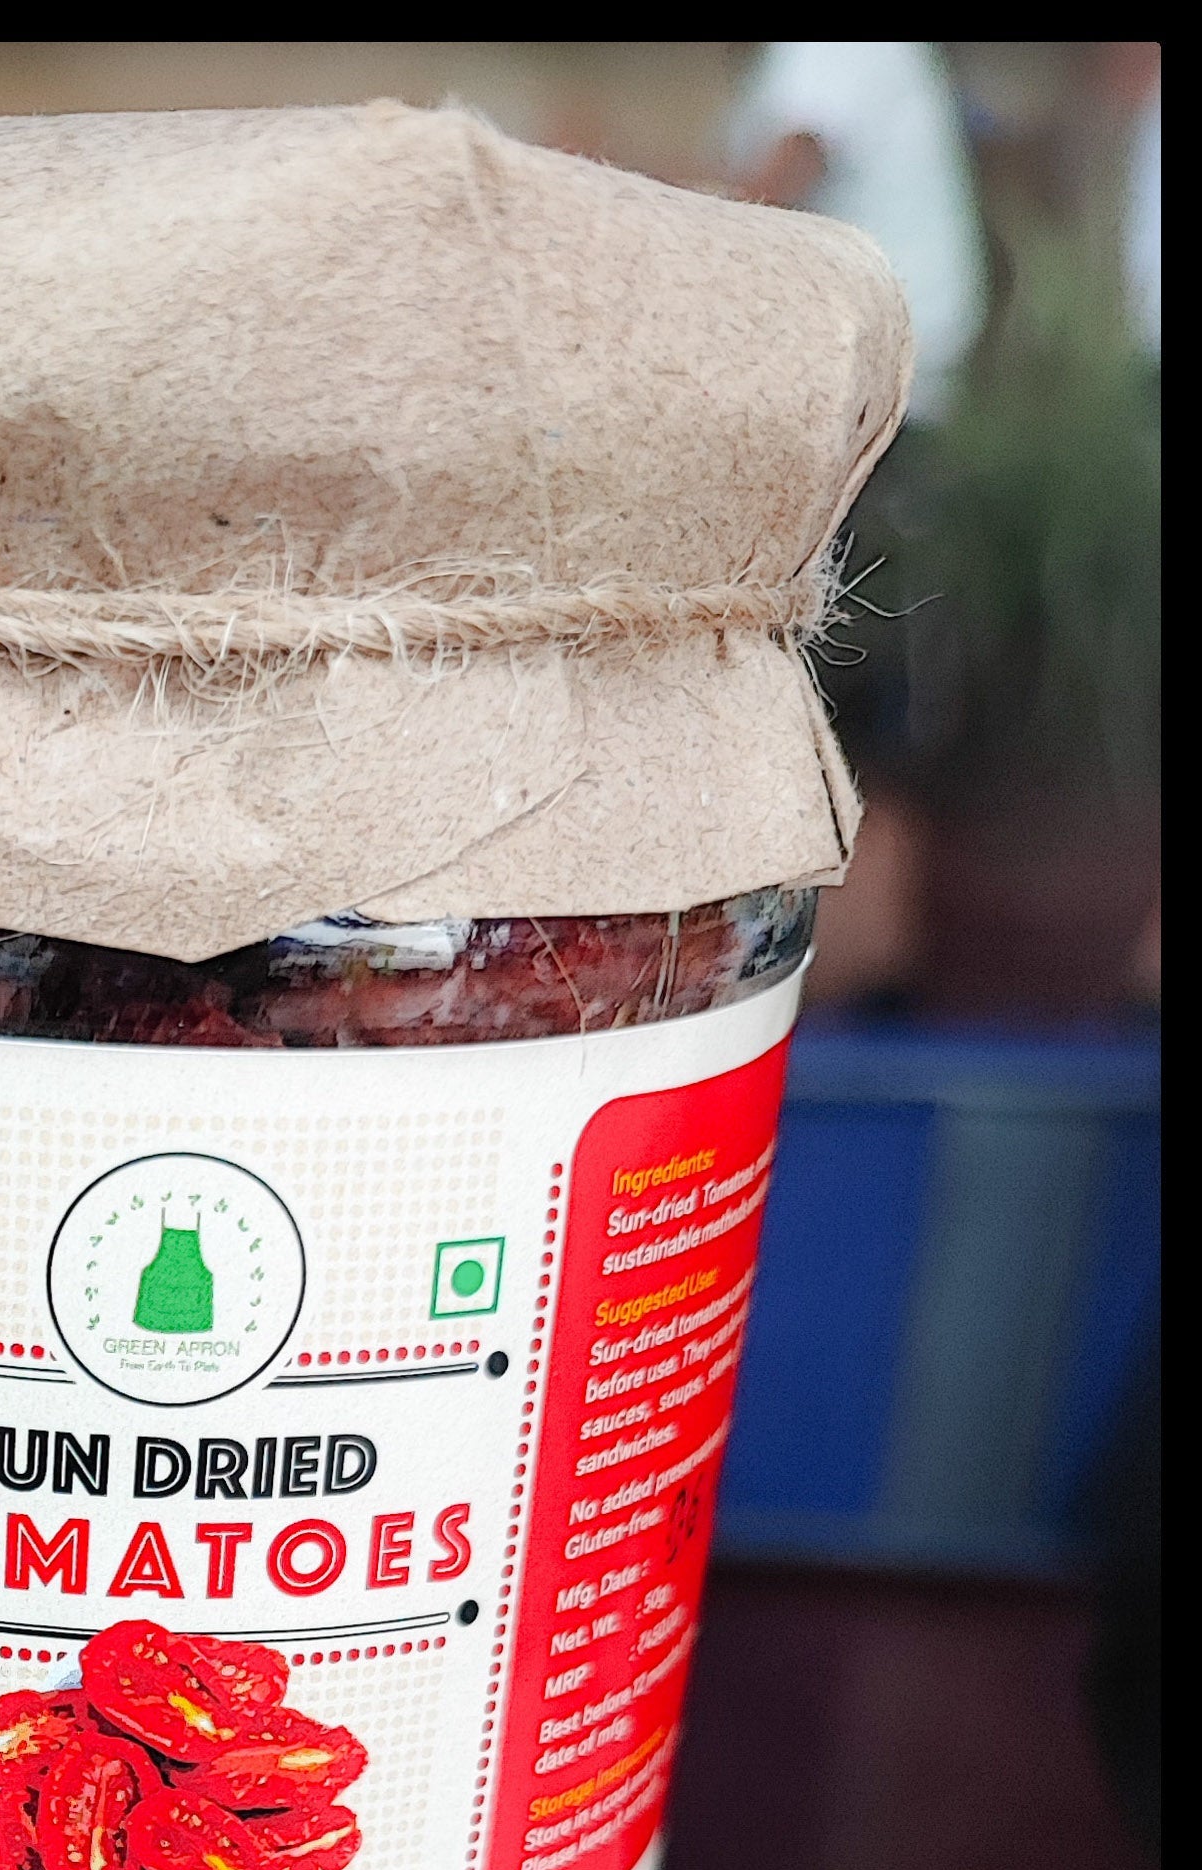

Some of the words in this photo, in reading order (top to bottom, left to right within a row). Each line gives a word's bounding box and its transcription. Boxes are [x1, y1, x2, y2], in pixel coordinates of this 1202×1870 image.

[612, 1149, 716, 1198] Ingredients:
[607, 1185, 698, 1238] Sun-dried
[602, 1224, 703, 1275] sustainable
[595, 1275, 689, 1326] Suggested
[103, 1338, 166, 1356] GREEN
[176, 1340, 241, 1357] APRON
[589, 1315, 678, 1366] Sun-dried
[585, 1366, 646, 1404] before
[133, 1434, 378, 1498] DRIED
[569, 1495, 600, 1526] No
[601, 1469, 656, 1514] added
[539, 1710, 582, 1744] Best
[535, 1744, 578, 1774] date
[529, 1777, 597, 1821] Storage
[523, 1817, 574, 1852] Store
